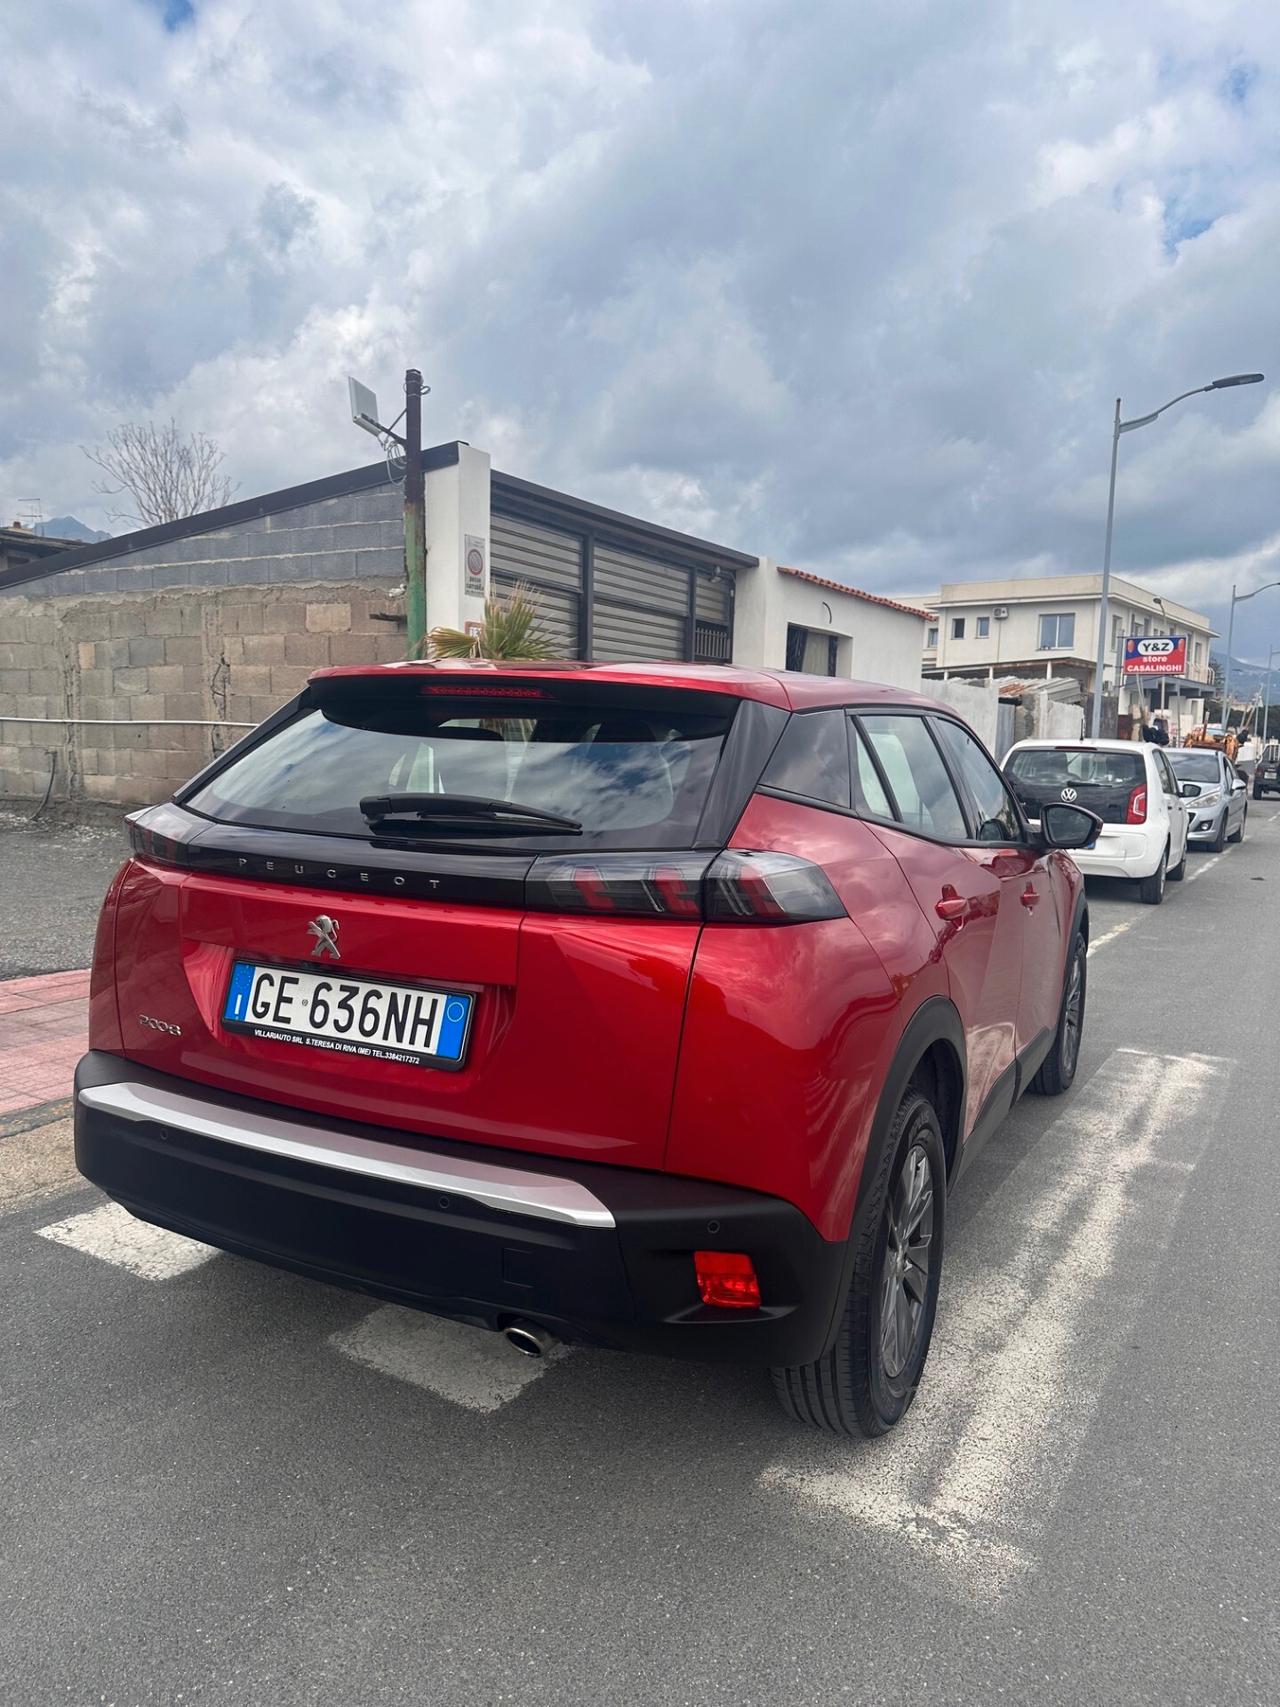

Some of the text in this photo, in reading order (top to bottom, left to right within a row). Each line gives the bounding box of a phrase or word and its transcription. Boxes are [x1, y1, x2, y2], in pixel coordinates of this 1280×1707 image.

[1142, 642, 1170, 652] Y&Z
[1142, 655, 1168, 663] store
[1127, 664, 1182, 672] CASALINGHI
[239, 857, 440, 889] PEUGEOT
[139, 1014, 182, 1036] 2008
[292, 1035, 304, 1044] SRL
[334, 1043, 342, 1051] DI
[342, 1044, 357, 1053] RIVA
[357, 1046, 372, 1056] (ME)
